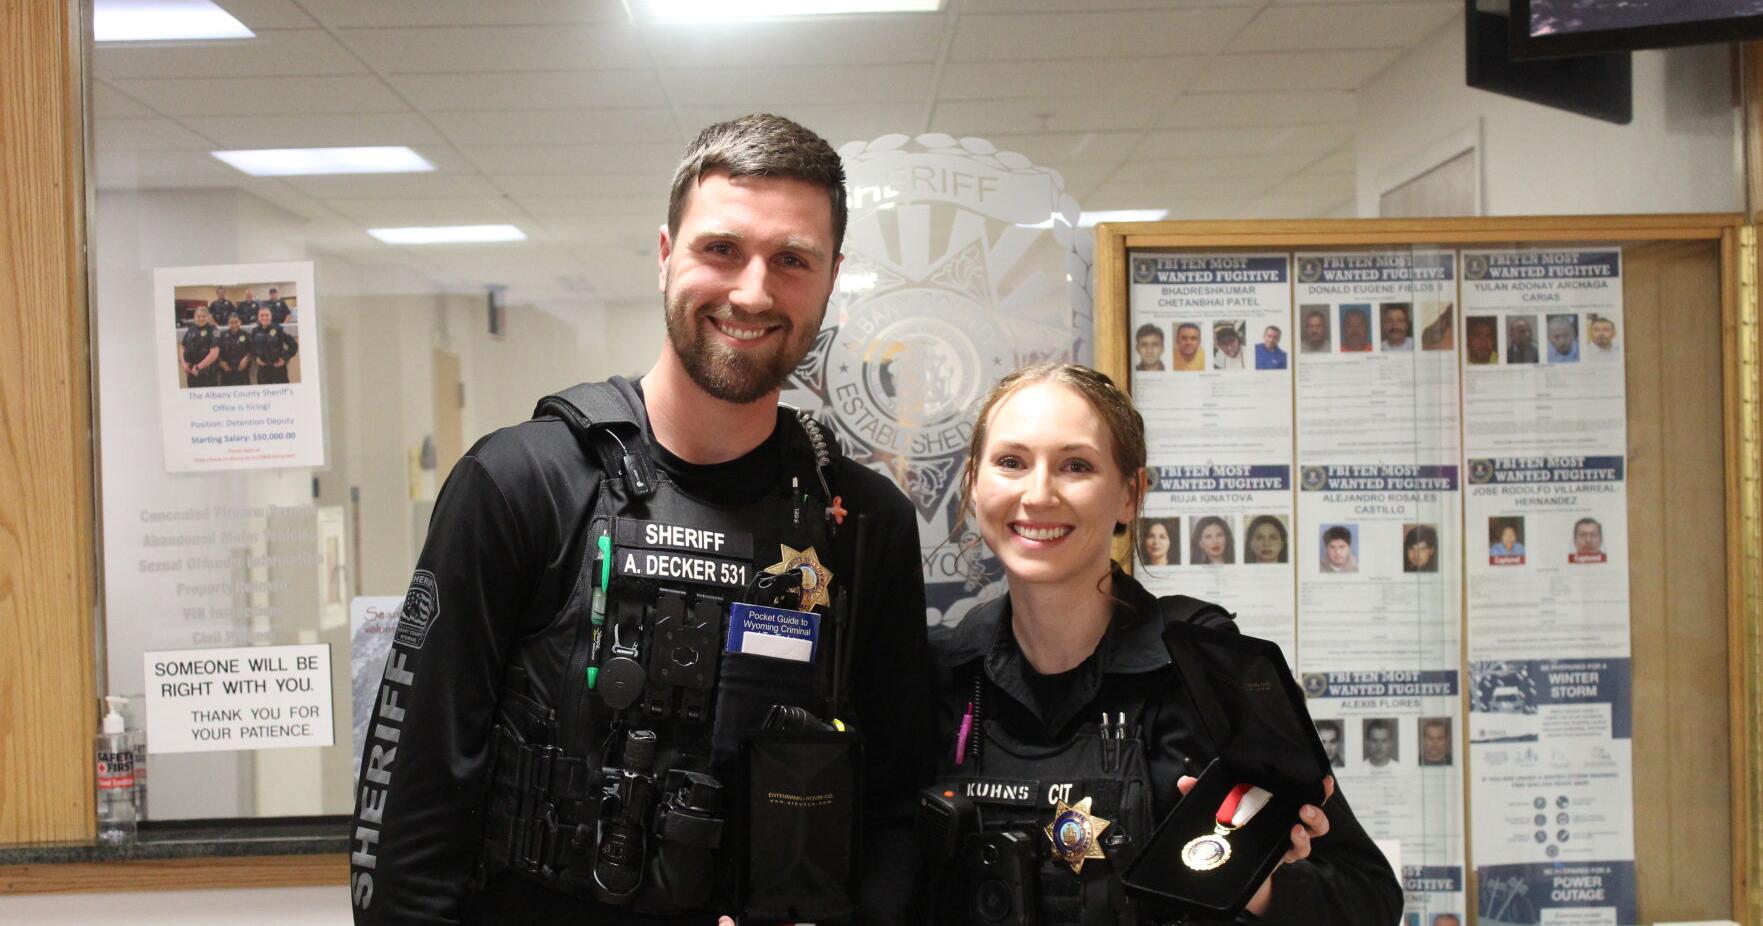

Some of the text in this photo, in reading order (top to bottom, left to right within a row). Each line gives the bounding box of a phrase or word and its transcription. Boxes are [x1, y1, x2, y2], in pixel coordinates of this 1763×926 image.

[1180, 258, 1207, 269] TEN
[1209, 258, 1248, 269] MOST
[1541, 253, 1580, 264] MOST
[1157, 270, 1279, 282] WANTED FUGITIVE
[1323, 267, 1445, 281] WANTED FUGITIVE
[1489, 264, 1611, 278] WANTED FUGITIVE
[1161, 286, 1256, 296] BHADRESHKUMAR
[1309, 285, 1351, 295] DONALD
[1354, 284, 1395, 294] EUGENE
[1398, 283, 1434, 293] FIELDS
[1474, 280, 1608, 292] YULAN ADONAY ARCHAGA
[1158, 297, 1260, 307] CHETANBHAI PATEL
[1522, 293, 1561, 302] CARIAS
[205, 390, 231, 400] Albany
[233, 389, 261, 399] County
[212, 403, 236, 412] Office
[266, 417, 295, 426] Deputy
[192, 435, 222, 445] Starting
[252, 431, 296, 441] $50,000.00
[1548, 456, 1585, 468] MOST
[1183, 466, 1210, 477] TEN
[1212, 465, 1251, 477] MOST
[1352, 465, 1378, 476] TEN
[1381, 465, 1420, 476] MOST
[1495, 468, 1616, 482] WANTED FUGITIVE
[1160, 477, 1282, 490] WANTED FUGITIVE
[1328, 477, 1450, 489] WANTED FUGITIVE
[1472, 484, 1616, 496] JOSE RODOLFO VILLARREAL
[1170, 494, 1253, 503] RUJA IGNATOVA
[1323, 493, 1437, 503] ALEJANDRO ROSALES
[1515, 496, 1577, 506] HERNANDEZ
[1354, 505, 1405, 514] CASTILLO
[645, 524, 725, 551] SHERIFF
[138, 558, 182, 573] Sexual
[624, 553, 746, 586] A. DECKER 531
[749, 610, 808, 627] Pocket Guide to
[743, 620, 779, 634] Wyoming
[781, 625, 811, 636] Criminal
[155, 656, 319, 677] SOMEONE WILL BE
[1352, 671, 1379, 683] TEN
[1382, 671, 1420, 682] MOST
[1548, 671, 1600, 685] WINTER
[161, 678, 314, 697] RIGHT WITH YOU.
[1328, 683, 1450, 696] WANTED FUGITIVE
[1551, 685, 1597, 698] STORM
[1341, 699, 1421, 709] ALEXIS FLORES
[191, 706, 319, 722] THANK YOU FOR
[191, 723, 314, 740] YOUR PATIENCE.
[352, 648, 415, 910] SHERIFF
[967, 783, 1073, 805] KUHNS CIT
[1403, 879, 1455, 890] GITIVE
[1553, 876, 1603, 888] POWER
[1551, 888, 1606, 902] OUTAGE
